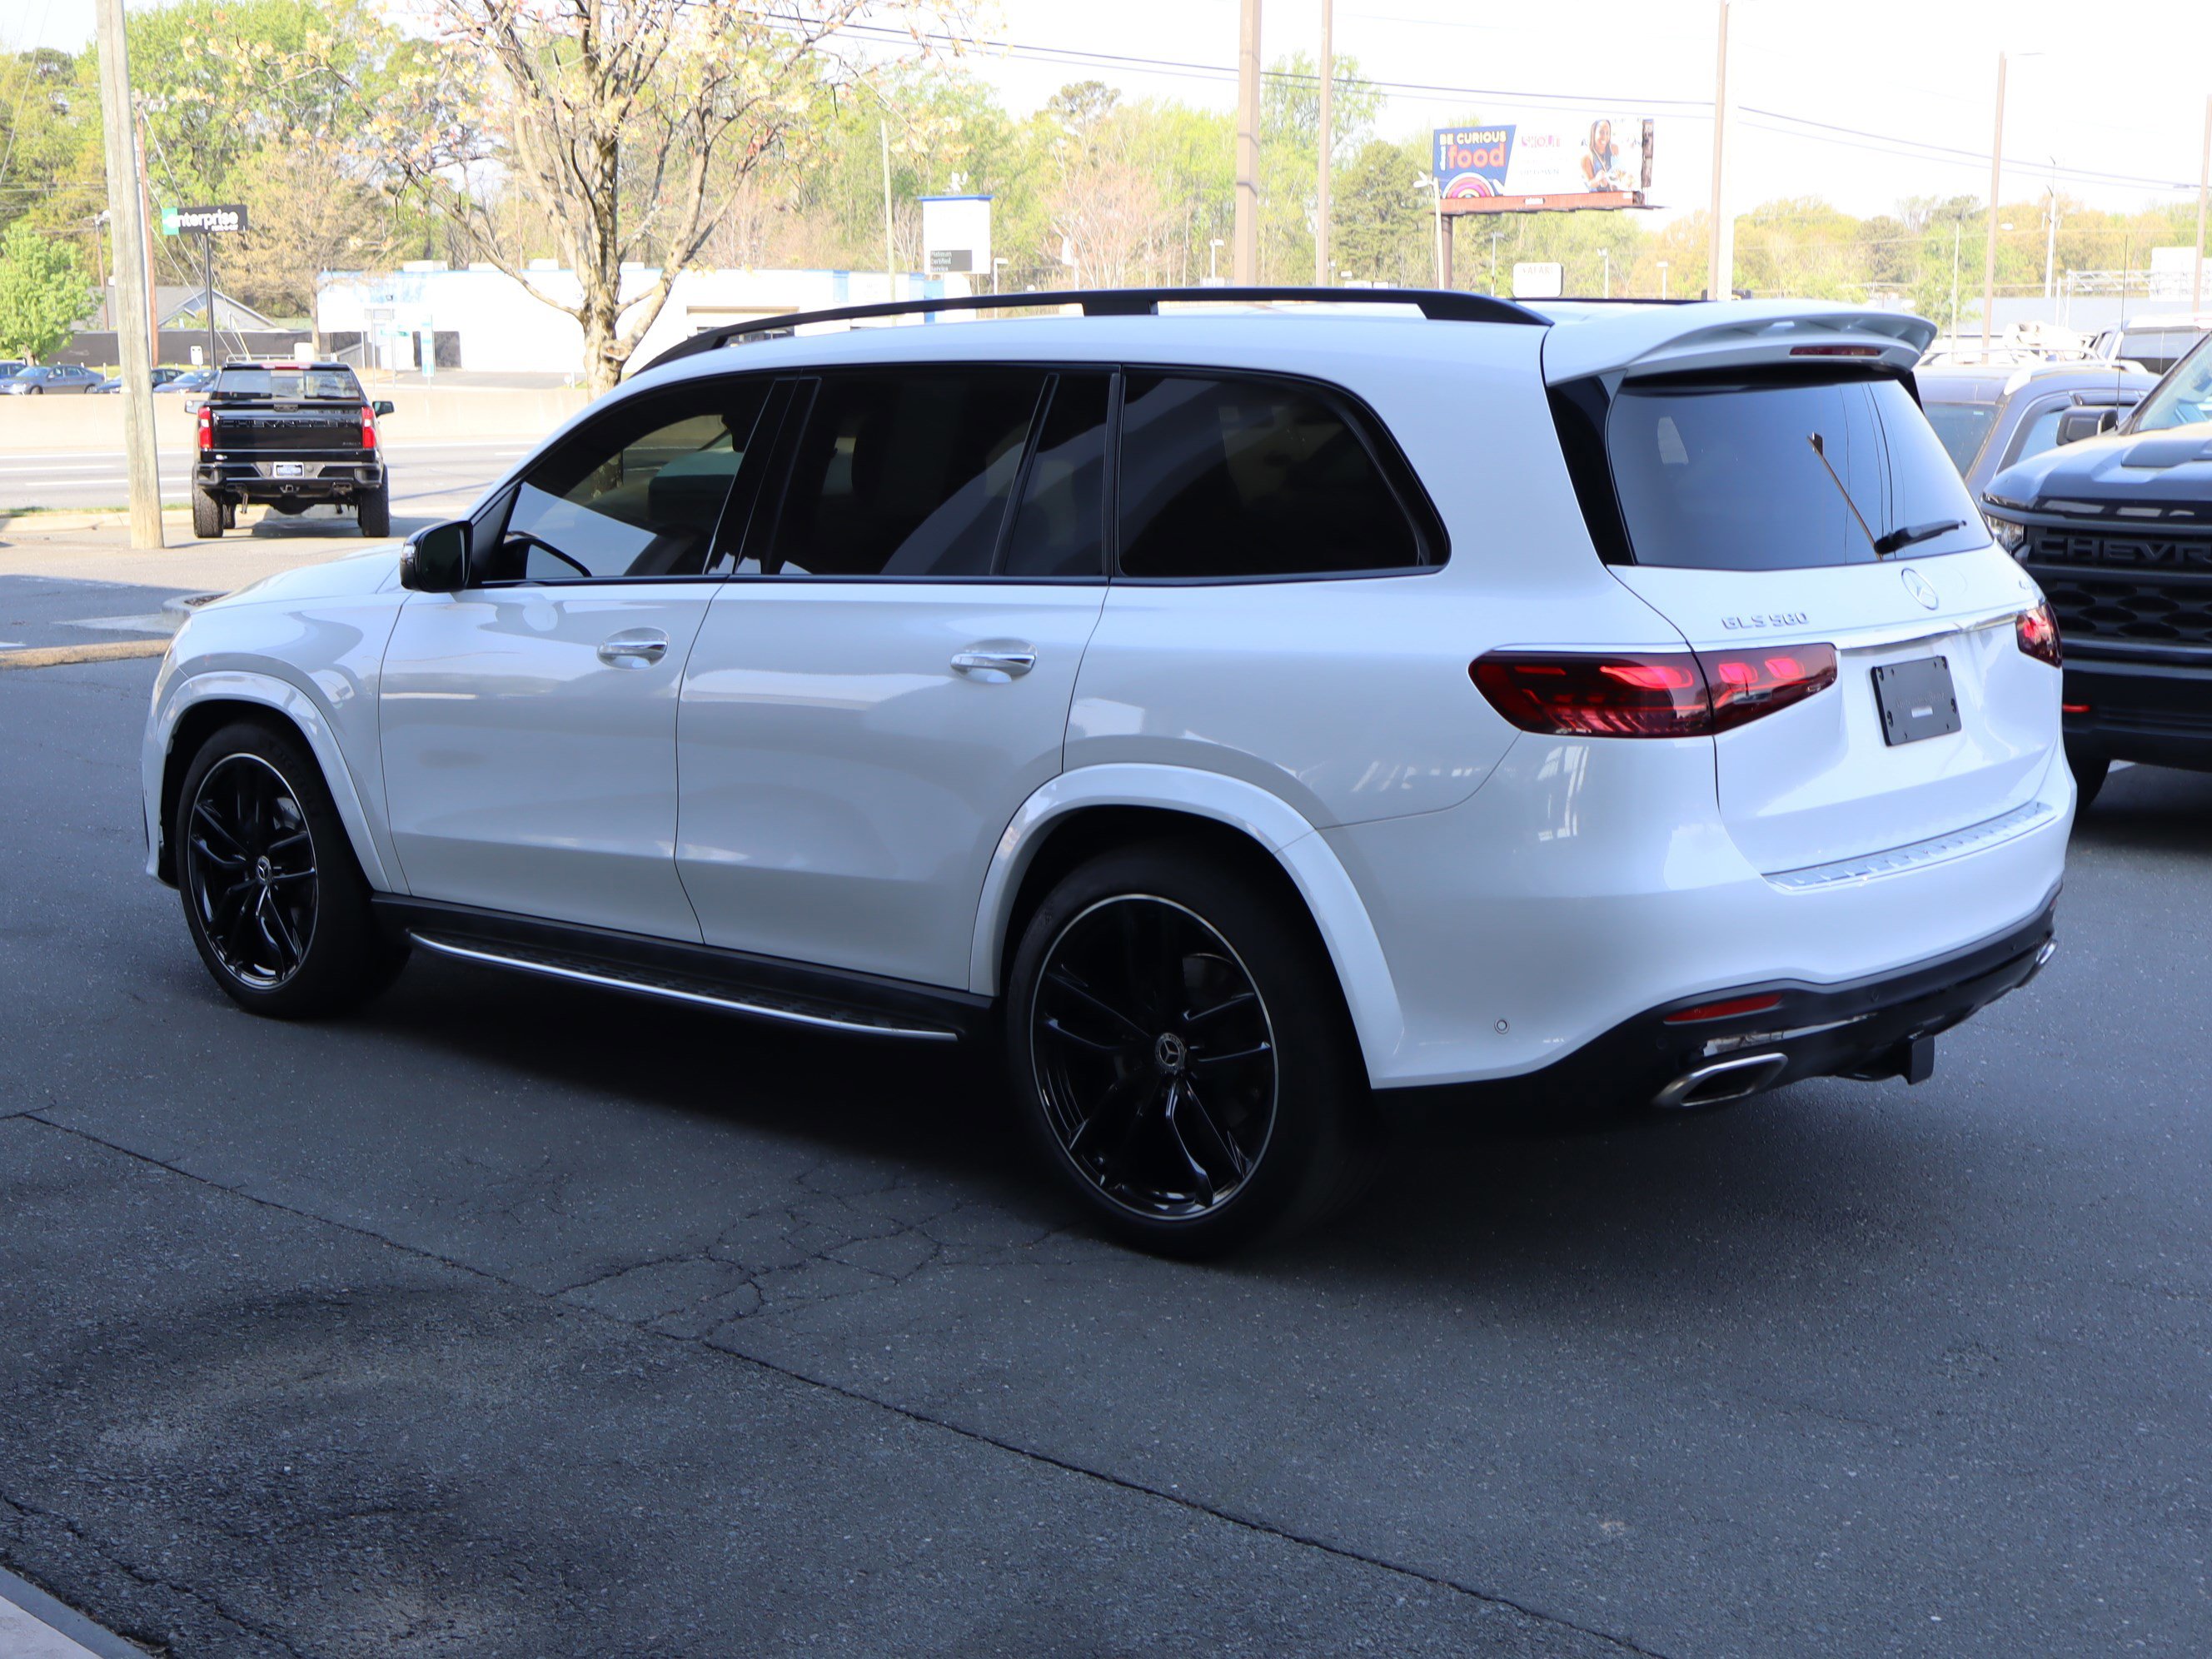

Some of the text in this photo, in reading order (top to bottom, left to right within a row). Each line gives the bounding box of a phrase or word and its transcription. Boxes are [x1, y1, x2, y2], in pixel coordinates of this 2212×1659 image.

[1439, 131, 1507, 146] BE CURIOUS
[1447, 142, 1506, 169] food
[163, 208, 239, 230] enterprise
[1721, 615, 1766, 630] GLS
